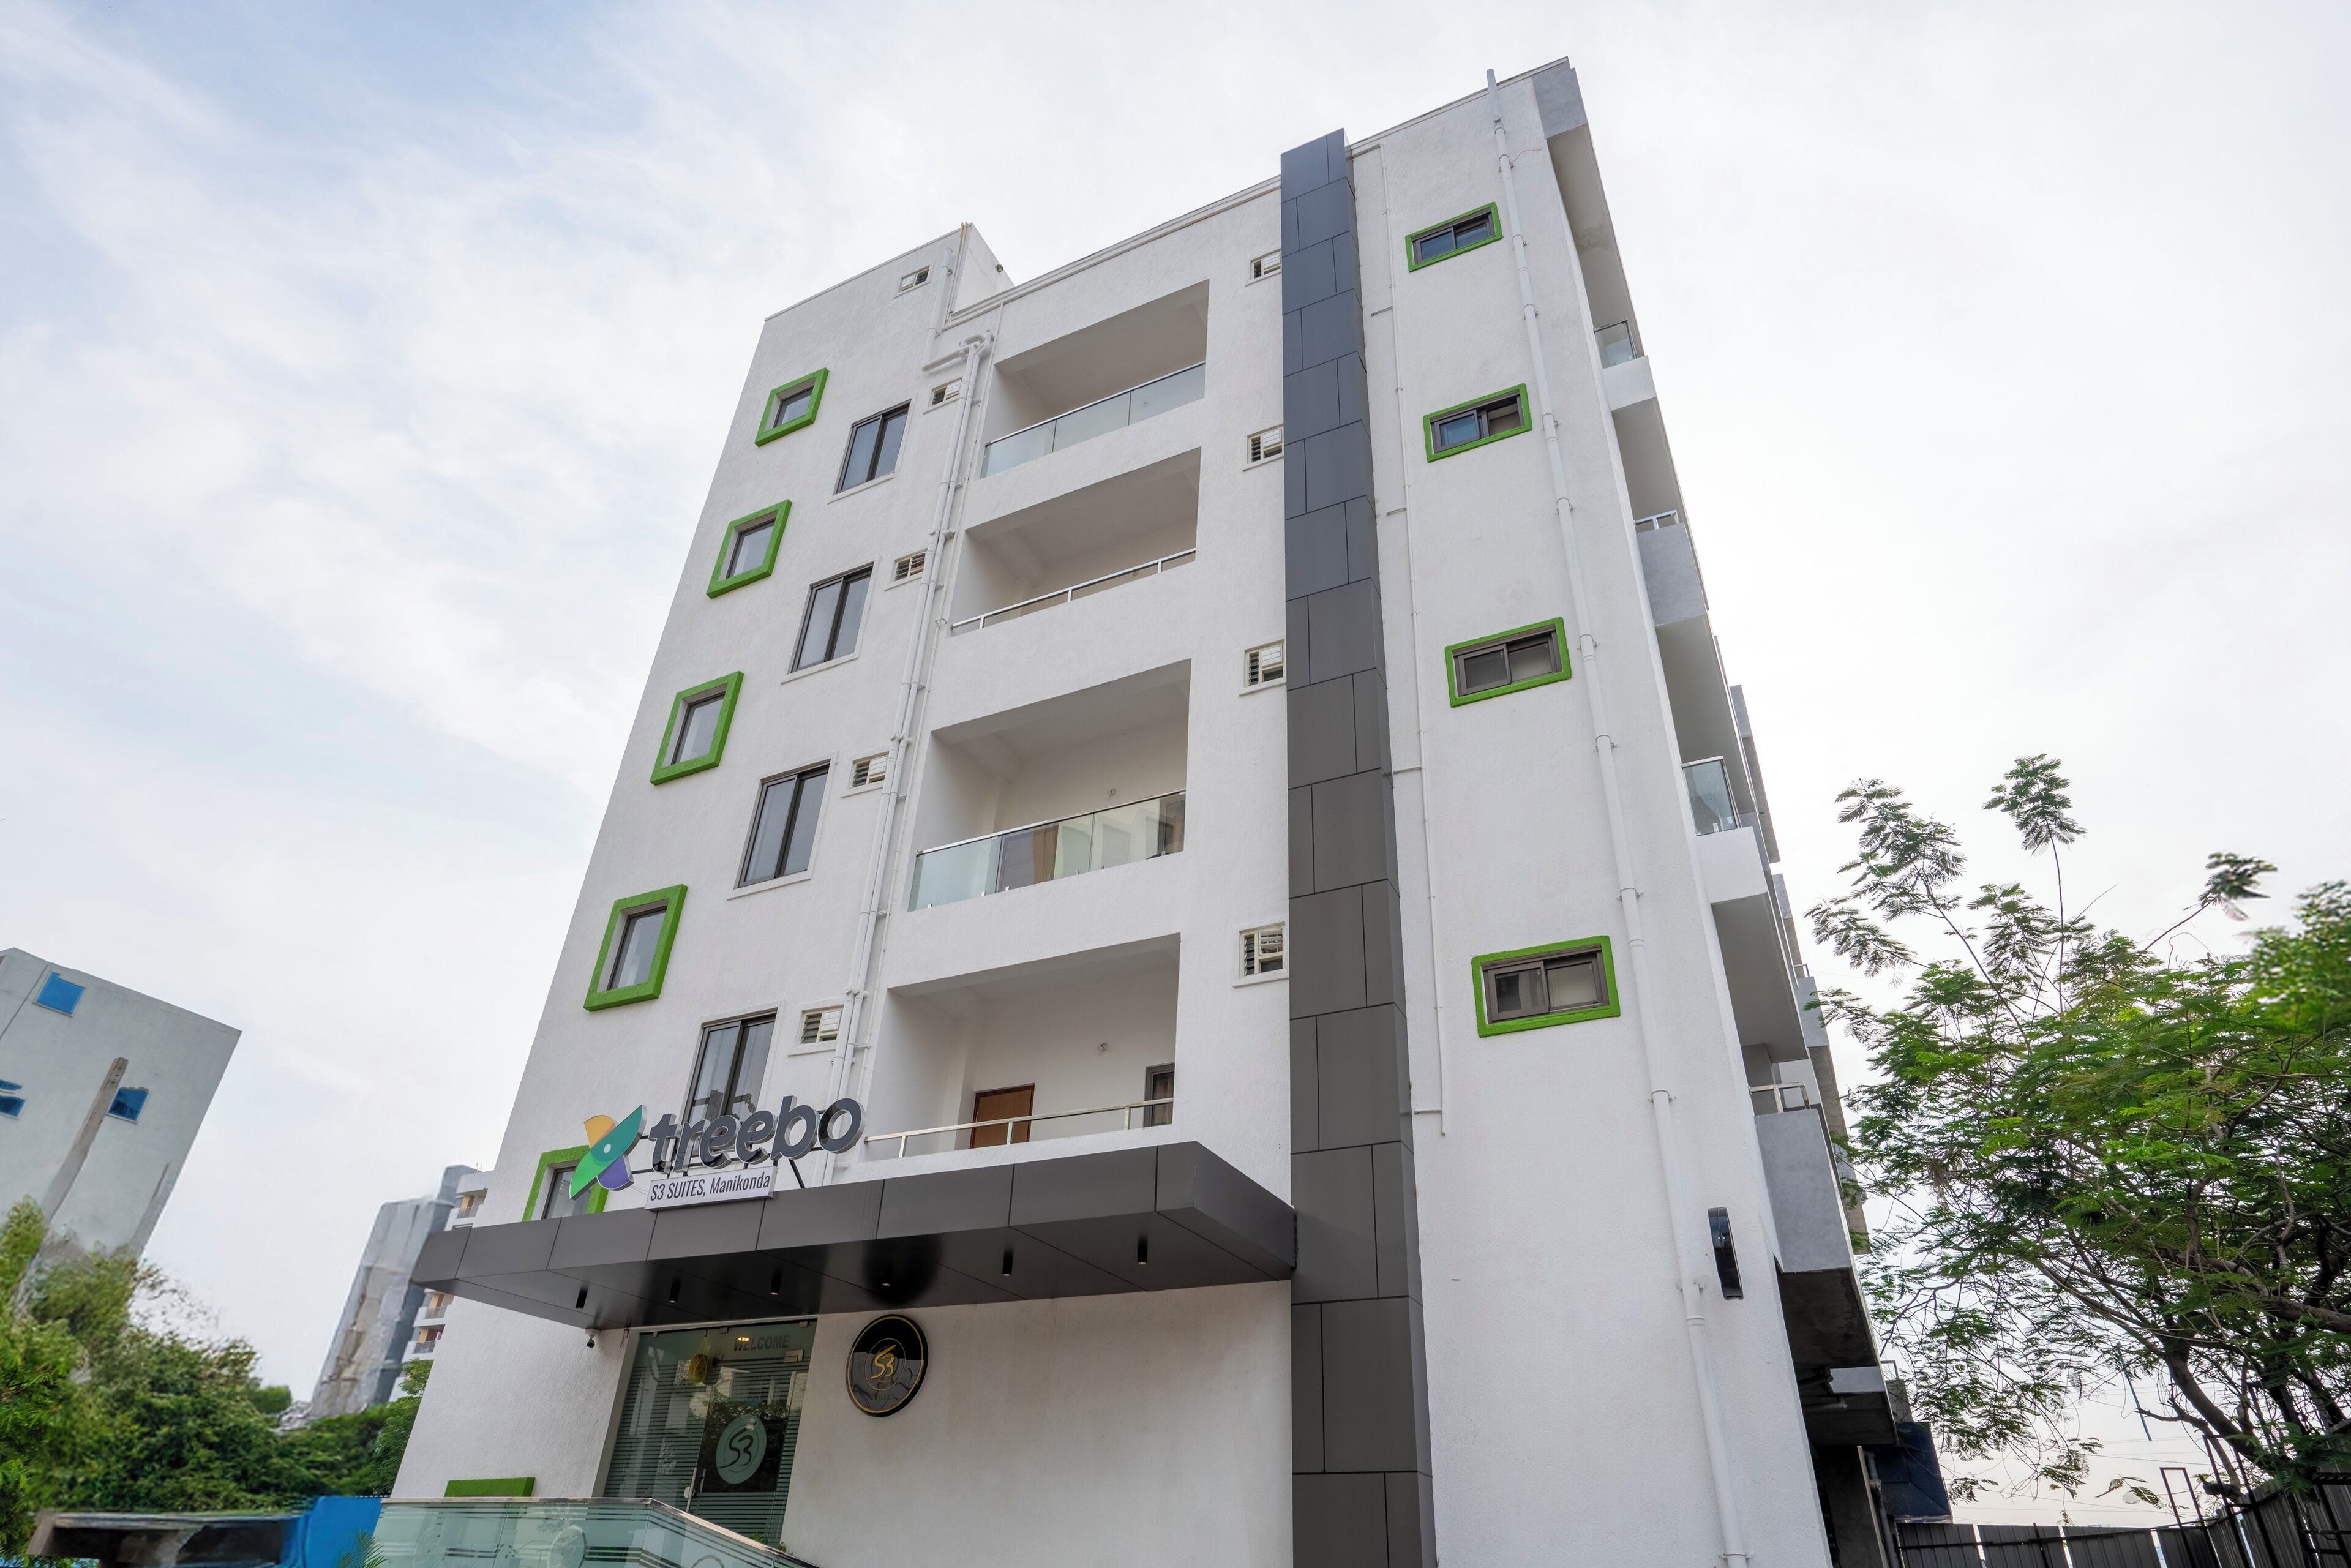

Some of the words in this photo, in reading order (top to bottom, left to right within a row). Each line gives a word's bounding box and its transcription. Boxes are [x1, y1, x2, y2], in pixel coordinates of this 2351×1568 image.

[649, 1095, 866, 1175] treebo
[650, 1184, 666, 1201] S3
[667, 1179, 705, 1198] SUITES,
[709, 1171, 770, 1195] Manikonda
[734, 1335, 790, 1352] WELCOME
